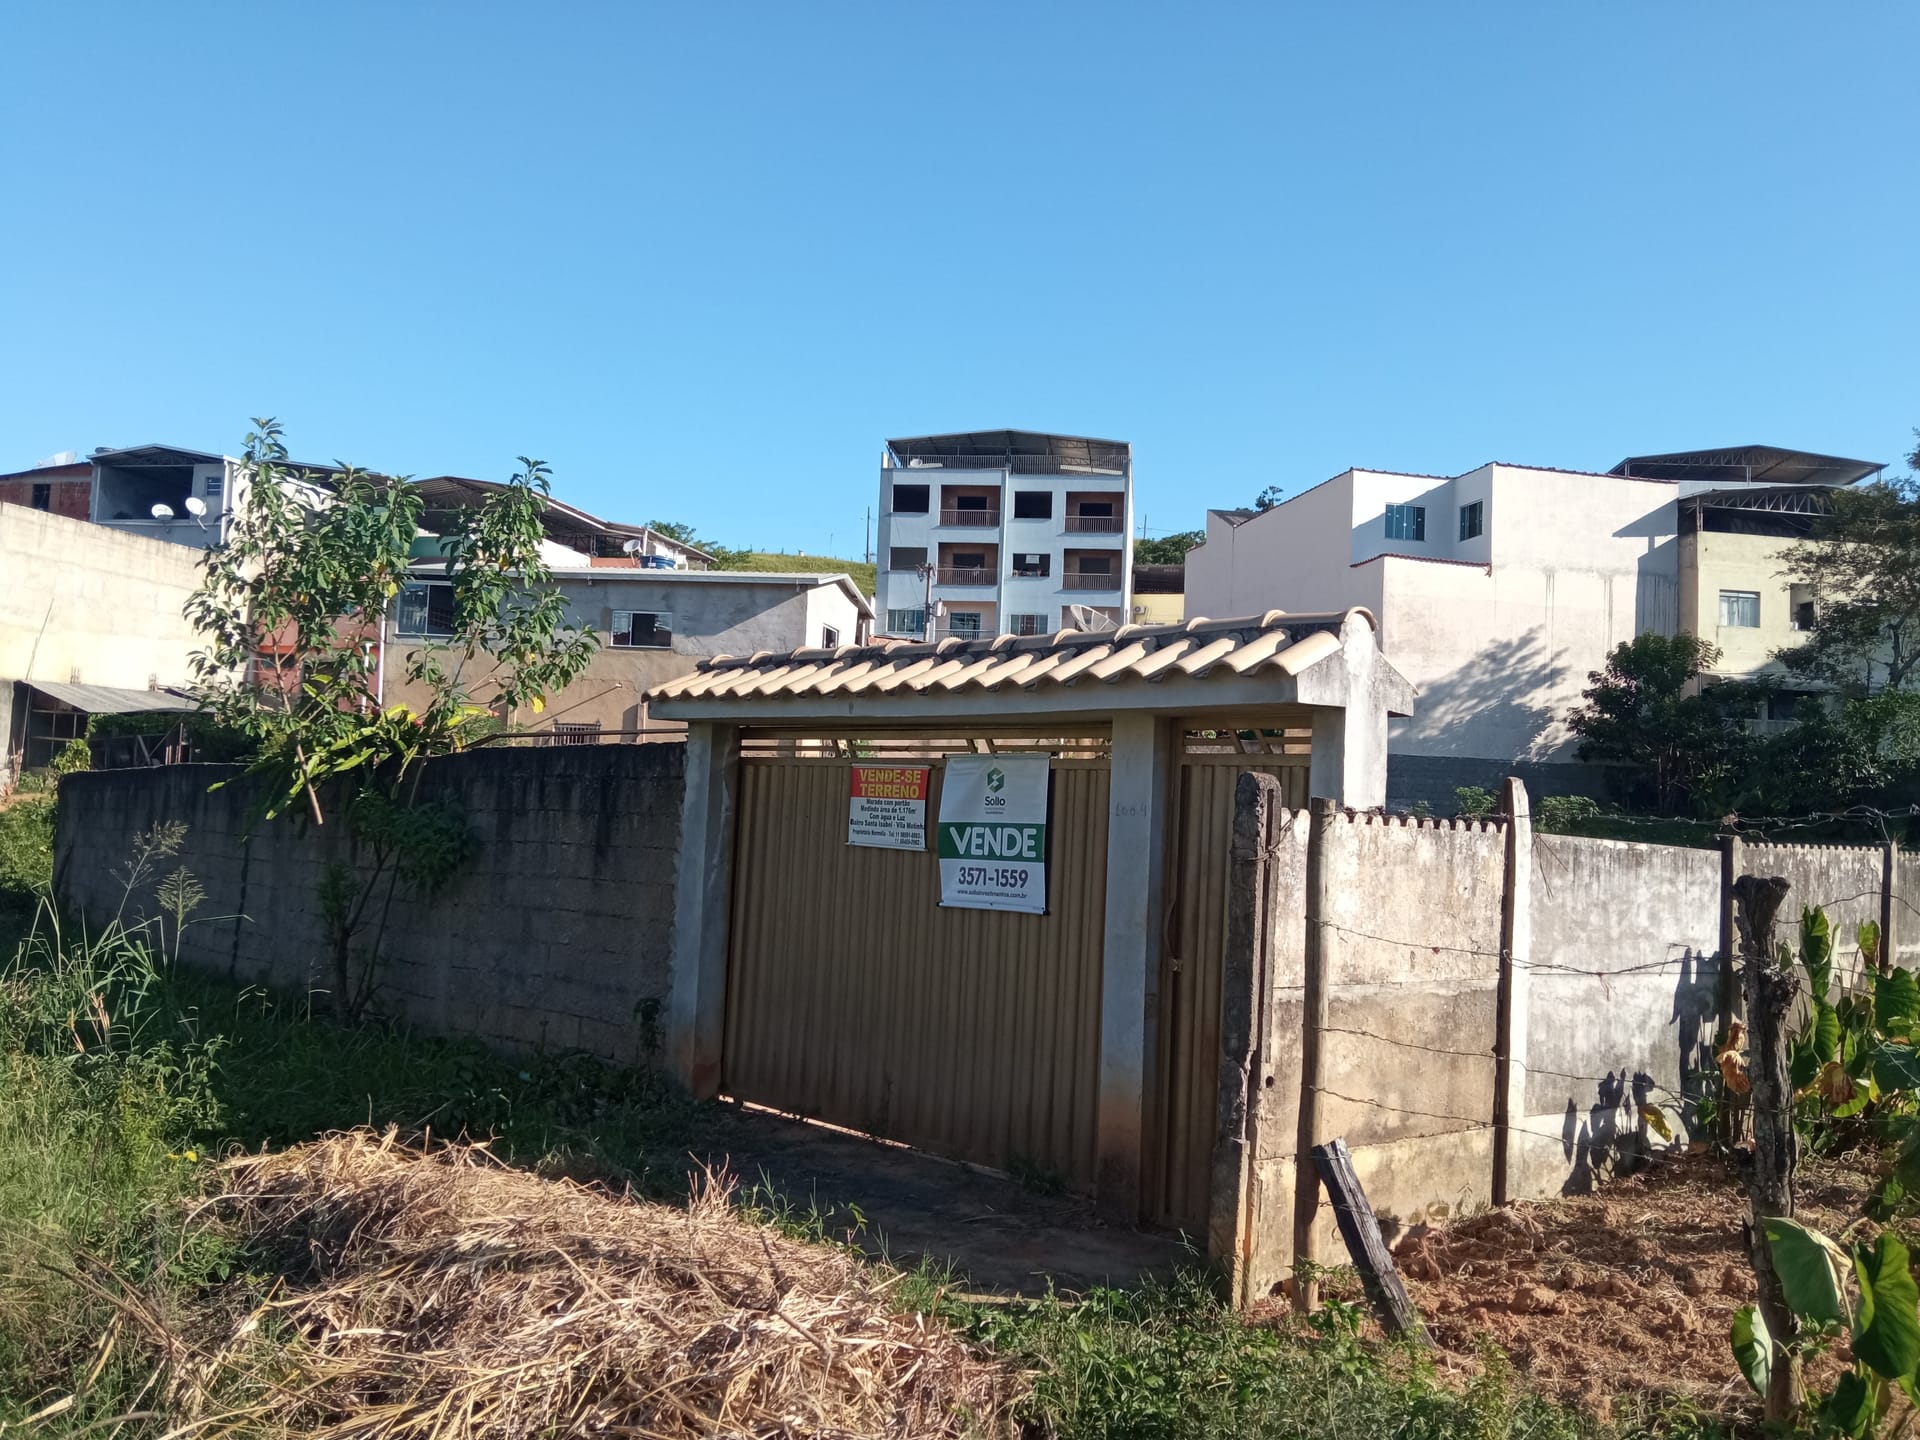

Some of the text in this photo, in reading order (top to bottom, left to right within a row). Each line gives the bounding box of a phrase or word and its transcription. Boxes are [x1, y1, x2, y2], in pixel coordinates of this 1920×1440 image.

[860, 769, 922, 784] VENDE-SE
[860, 784, 920, 799] TERRENO
[985, 796, 1006, 806] Sollo
[878, 820, 893, 828] Isabel
[896, 821, 906, 829] Vila
[949, 826, 1037, 858] VENDE
[958, 866, 1029, 889] 3571-1559
